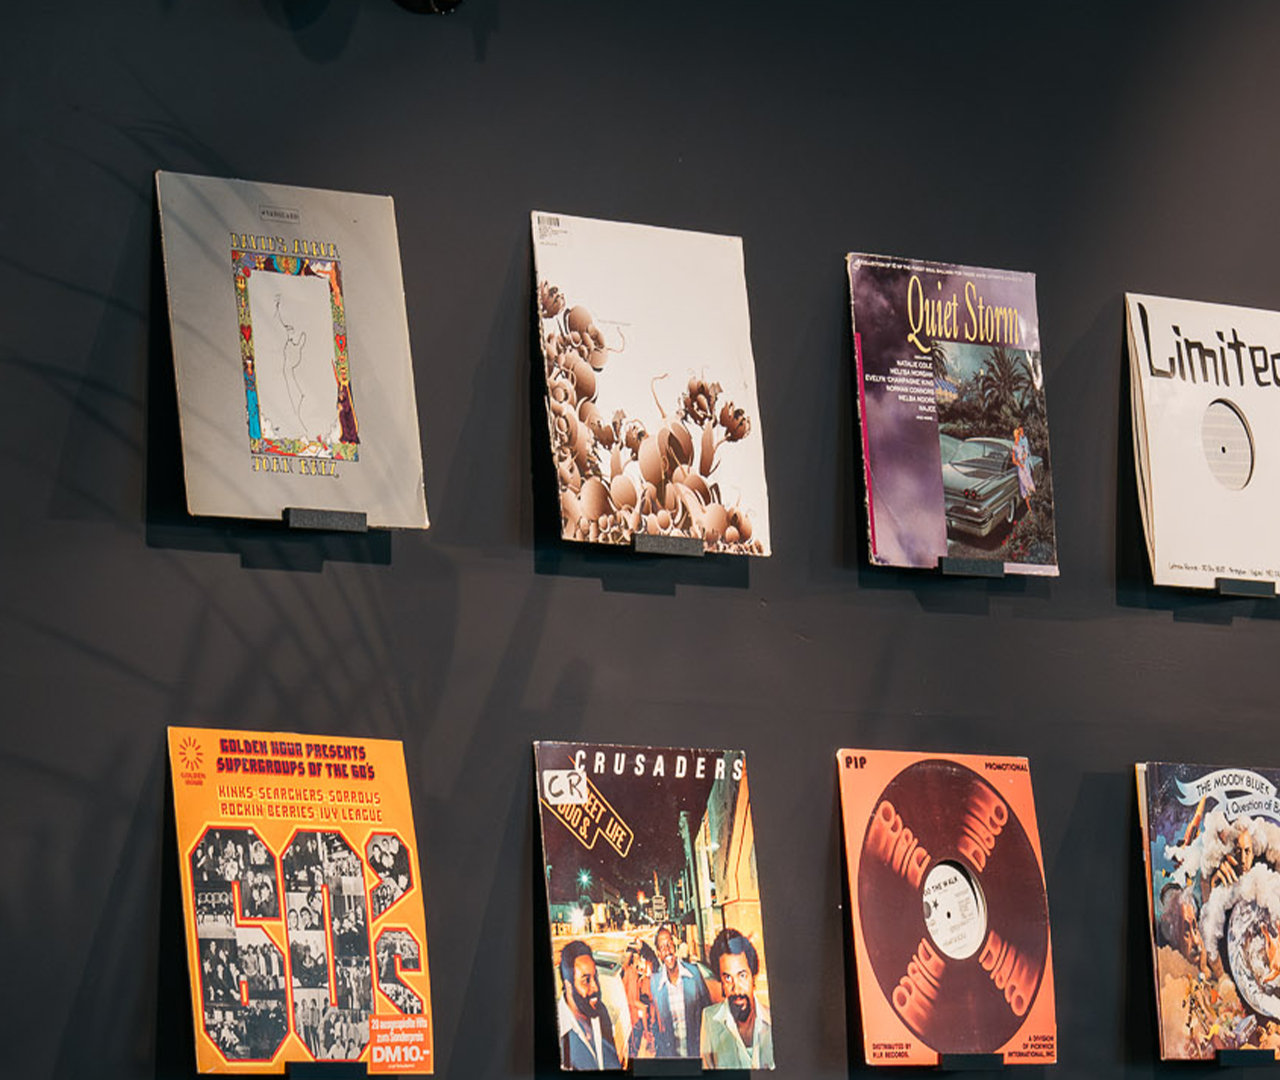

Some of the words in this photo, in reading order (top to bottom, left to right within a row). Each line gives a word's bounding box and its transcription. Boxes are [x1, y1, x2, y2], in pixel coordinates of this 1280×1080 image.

[907, 275, 960, 354] Quiet
[964, 281, 1020, 345] Storm
[219, 738, 268, 757] GOLDEN
[269, 740, 303, 759] HOUR
[305, 743, 366, 762] PRESENTS
[216, 756, 305, 778] SUPERGROUPS
[307, 761, 322, 779] OF
[325, 763, 349, 780] THE
[574, 750, 745, 781] CRUSADERS
[845, 756, 867, 769] PIP
[984, 762, 1028, 773] PROMOTIONAL
[218, 785, 254, 799] KINKS
[258, 787, 324, 802] SEARCHERS
[328, 790, 382, 804] SORROWS
[547, 771, 584, 799] CR
[1196, 779, 1212, 797] THE
[1213, 773, 1244, 790] MOODY
[1245, 775, 1270, 796] BLUES
[220, 802, 263, 817] ROCKIN
[267, 804, 315, 819] BERRIES
[320, 807, 339, 820] IVY
[342, 808, 383, 822] LEAGUE
[1231, 800, 1264, 815] Question
[1264, 798, 1273, 810] of
[605, 817, 627, 849] LIFE
